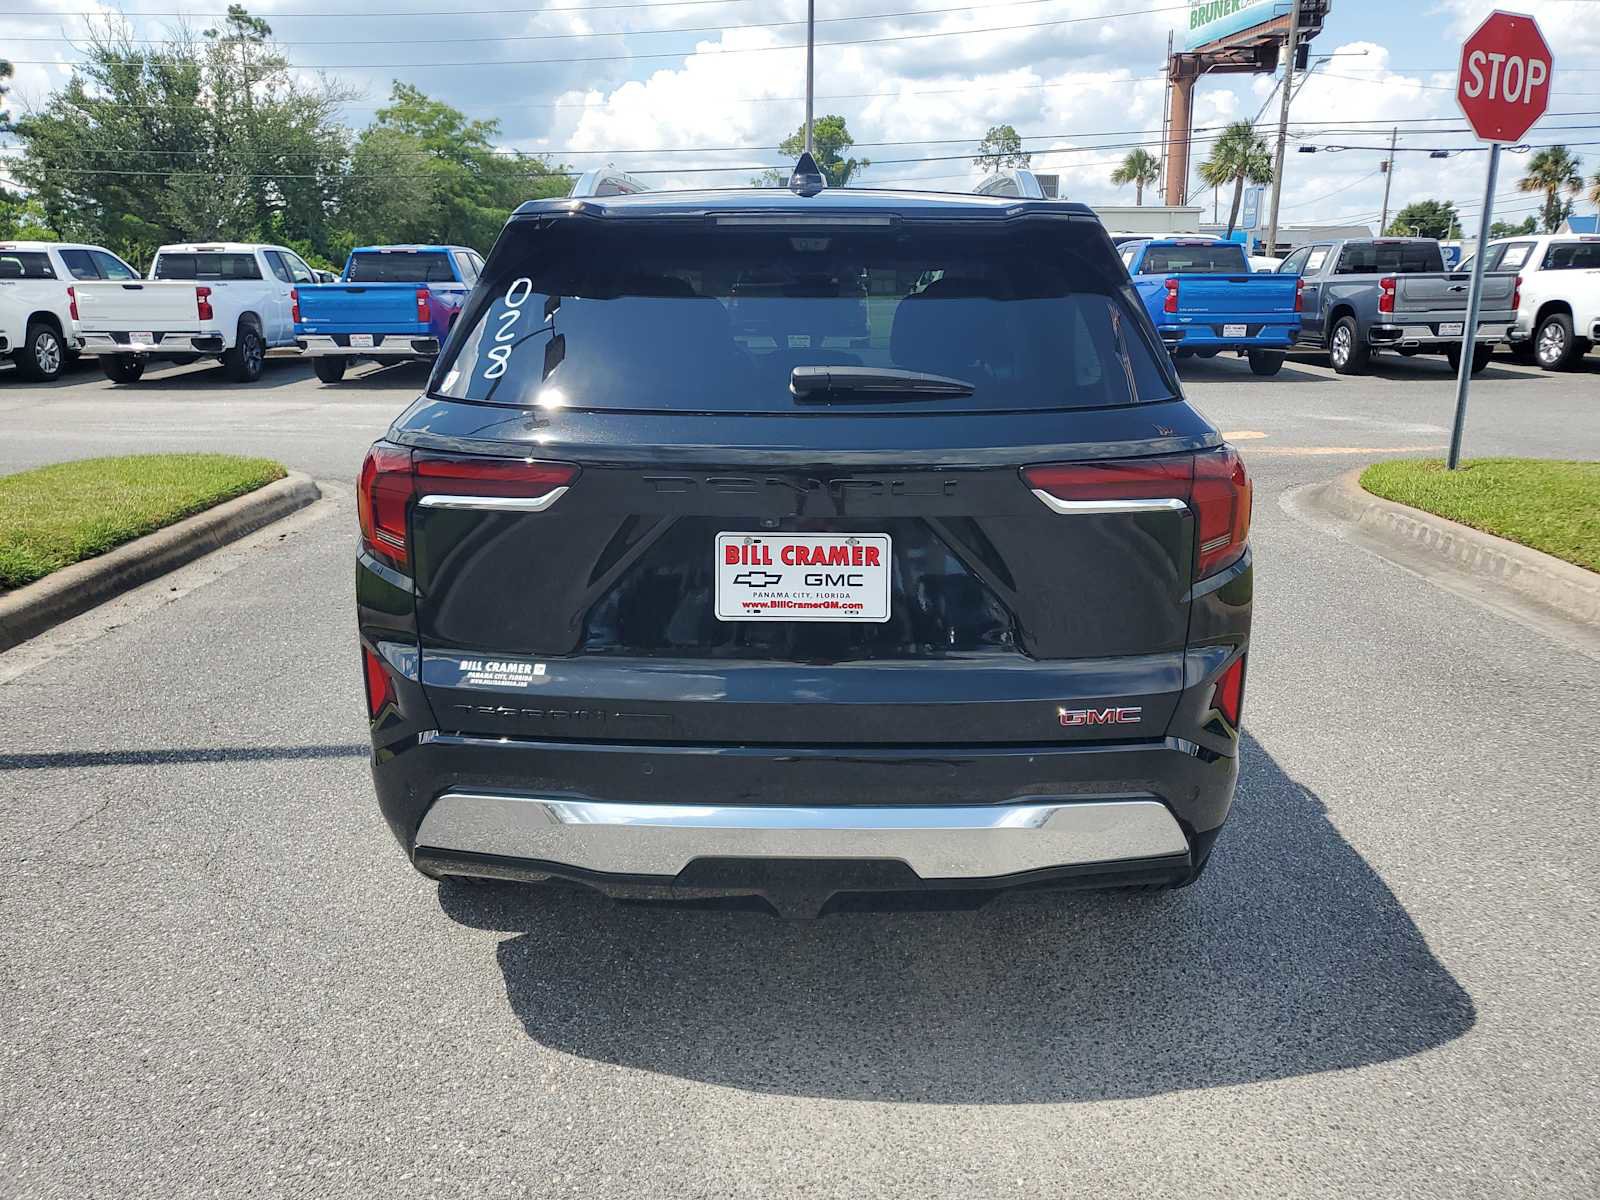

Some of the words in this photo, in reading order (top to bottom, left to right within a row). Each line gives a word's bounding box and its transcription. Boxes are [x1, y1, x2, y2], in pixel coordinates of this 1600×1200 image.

[1464, 50, 1547, 104] STOP
[483, 277, 533, 379] 028
[725, 545, 773, 566] BILL
[780, 545, 880, 567] CRAMER
[804, 573, 864, 587] GMC
[752, 591, 790, 599] PANAMA
[792, 591, 813, 600] CITY,
[815, 592, 851, 600] FLORIDA
[742, 600, 864, 610] www.BillCramerGM.com
[459, 660, 483, 671] BILL
[485, 662, 533, 674] CRAMER
[1059, 706, 1142, 726] GMC
